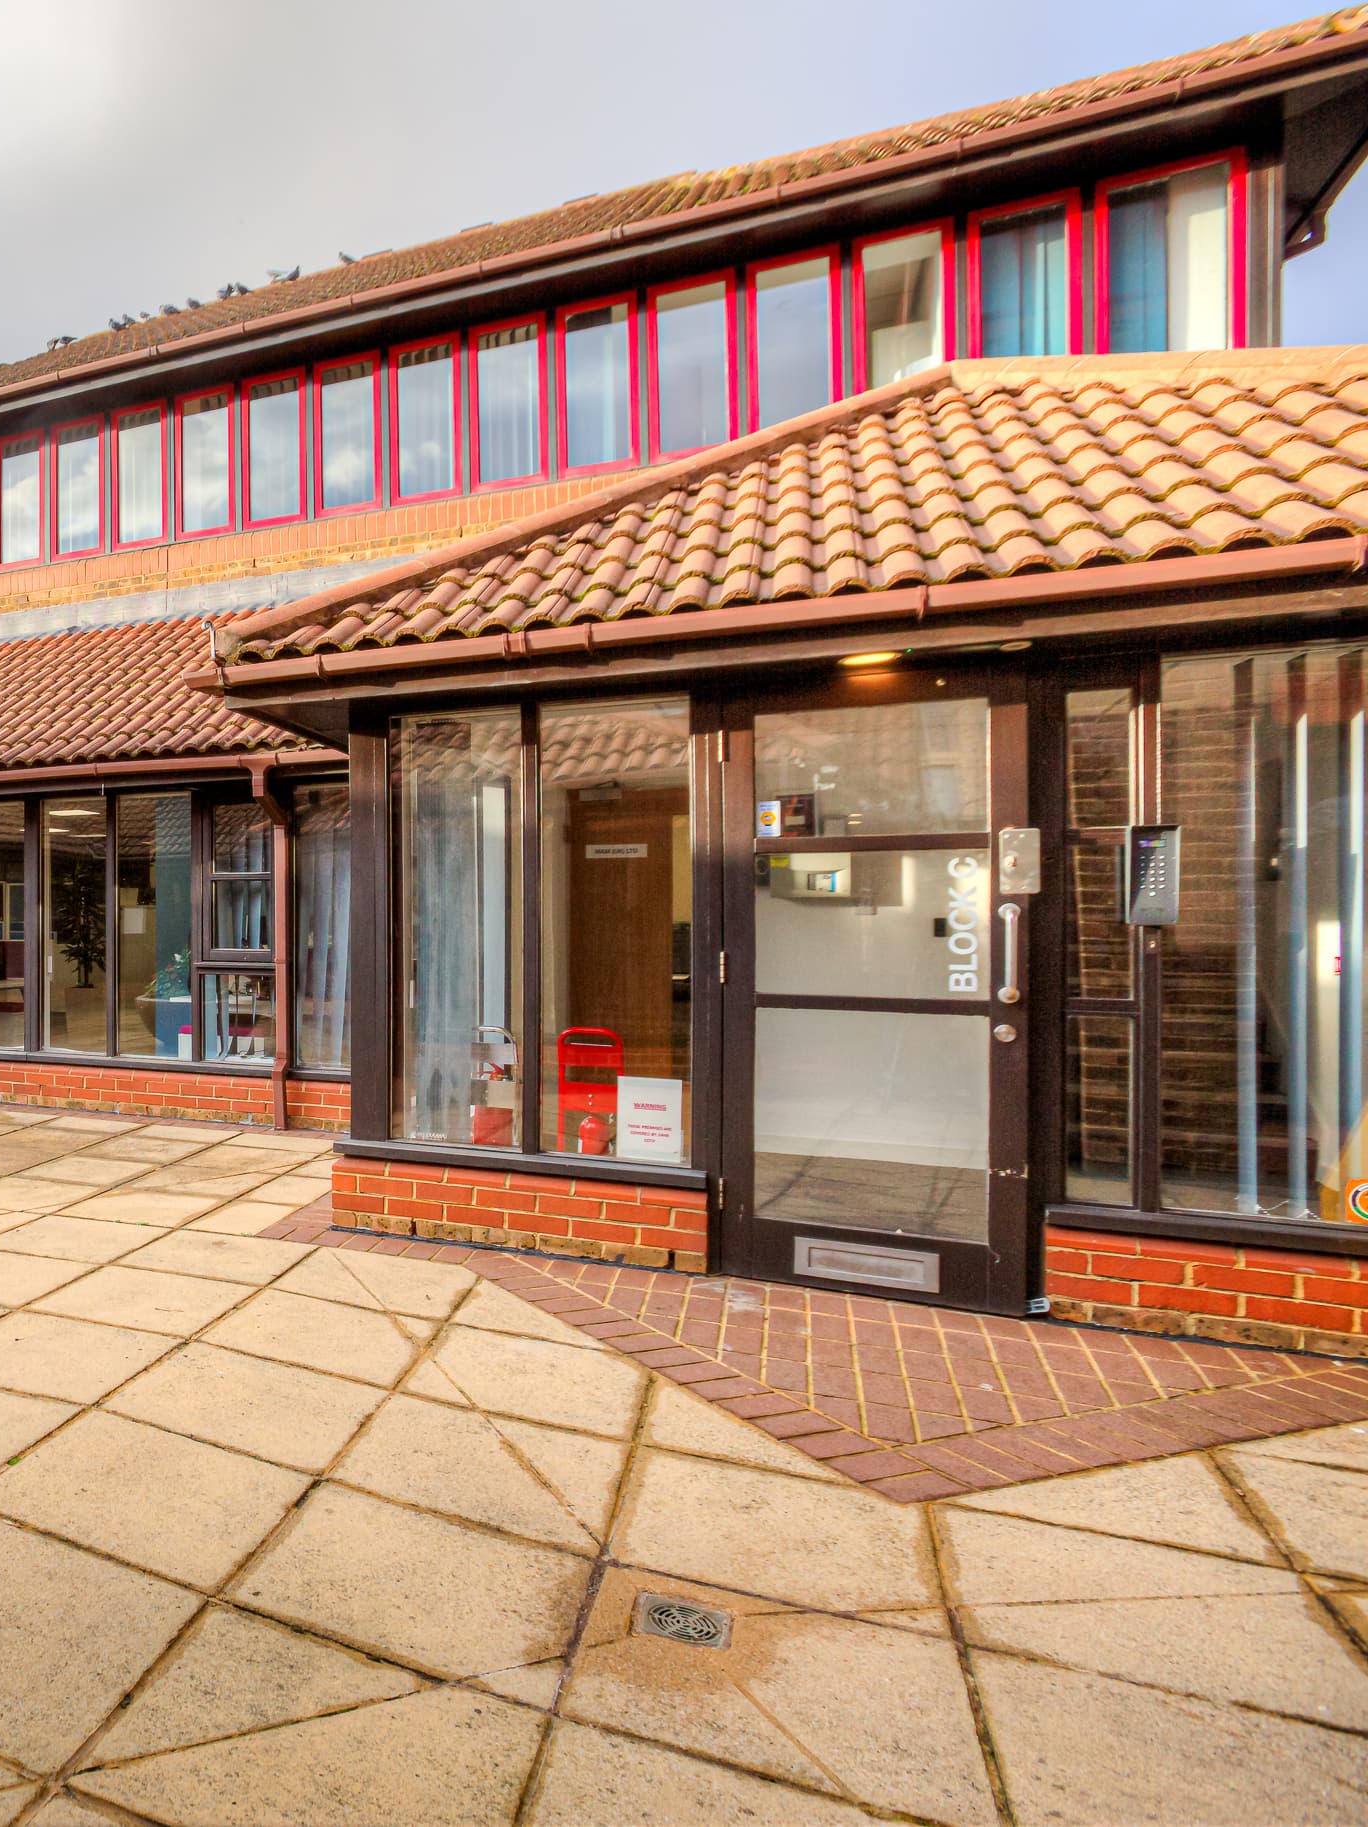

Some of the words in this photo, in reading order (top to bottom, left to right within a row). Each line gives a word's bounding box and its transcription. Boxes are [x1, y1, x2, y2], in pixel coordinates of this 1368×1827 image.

[947, 857, 978, 879] C
[948, 887, 978, 992] BLOCK
[633, 1103, 667, 1111] WARNING
